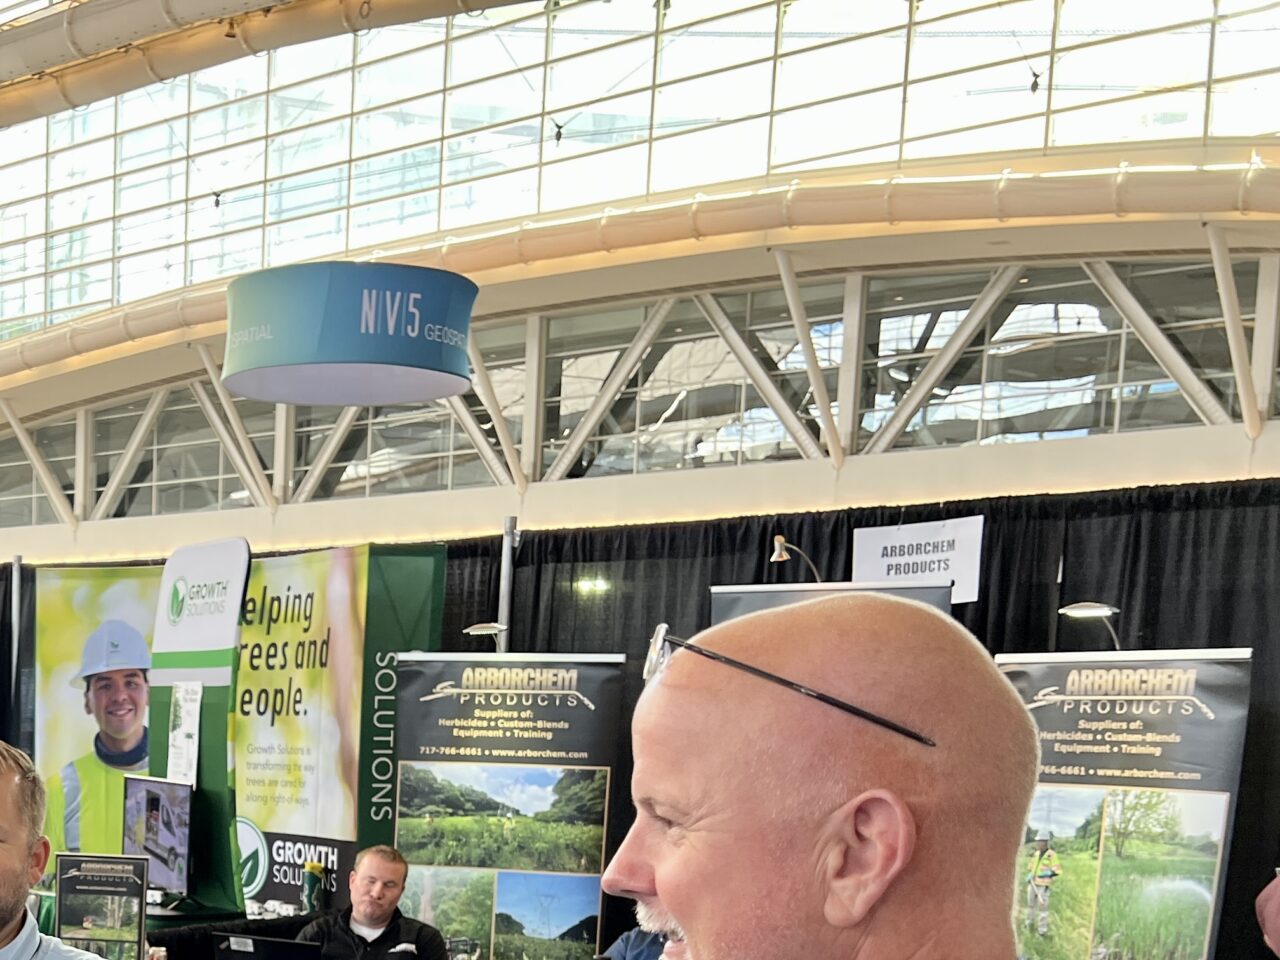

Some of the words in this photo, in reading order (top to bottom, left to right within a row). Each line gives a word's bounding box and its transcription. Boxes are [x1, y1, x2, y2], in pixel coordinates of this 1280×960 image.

[360, 288, 422, 337] NV5
[231, 322, 274, 348] SPATIAL
[881, 539, 955, 558] ARBORCHEM
[887, 558, 950, 576] PRODUCTS
[188, 580, 229, 600] GROWTH
[242, 585, 314, 636] elping
[239, 640, 289, 671] rees
[295, 627, 331, 669] and
[461, 667, 578, 690] ARBORCHEM
[1066, 668, 1197, 695] ARBORCHEM
[240, 677, 308, 727] eople.
[460, 693, 577, 706] PRODUCTS
[1064, 700, 1193, 715] PRODUCTS
[438, 718, 488, 727] Herbicides
[497, 720, 569, 729] Custom-Blends
[474, 709, 518, 719] Suppliers
[520, 709, 533, 718] of:
[453, 728, 503, 738] Equipment
[513, 729, 553, 740] Training
[1077, 719, 1127, 730] Suppliers
[1129, 720, 1143, 729] of:
[371, 652, 398, 821] SOLUTIONS
[1104, 732, 1181, 743] Custom-Blends
[492, 749, 588, 759] www.arborchem.com
[1054, 743, 1111, 754] Equipment
[1120, 744, 1162, 756] Training
[1039, 765, 1086, 776] 766-6661
[1097, 768, 1201, 780] www.arborchem.com
[272, 840, 338, 870] GROWTH
[273, 864, 337, 892] SOLUNS
